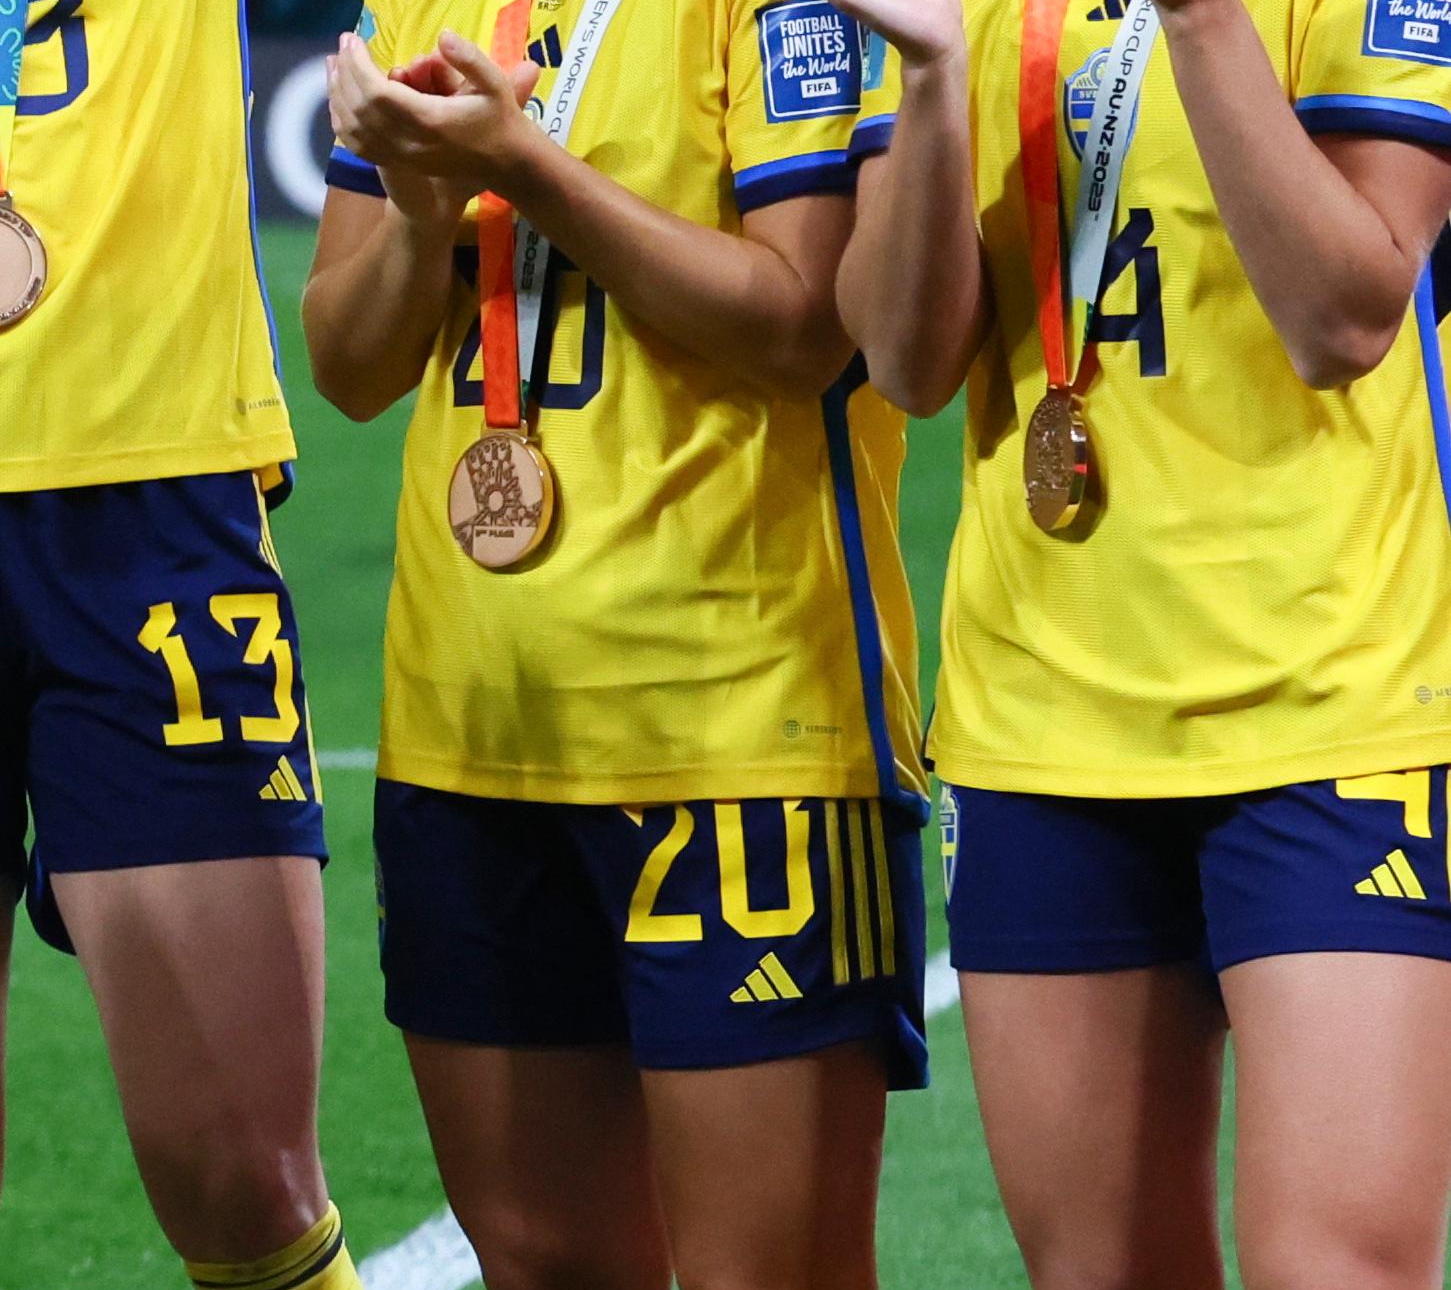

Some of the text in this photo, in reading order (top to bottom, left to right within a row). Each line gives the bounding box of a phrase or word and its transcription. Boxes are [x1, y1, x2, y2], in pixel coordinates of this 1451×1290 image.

[780, 14, 843, 37] FOOTBALL
[1410, 26, 1433, 38] FIFA
[783, 31, 846, 59] UNITES
[1120, 36, 1140, 76] CUP
[557, 46, 588, 112] WORLD
[780, 53, 851, 79] the World
[806, 82, 832, 93] FIFA
[1091, 210, 1165, 376] 4
[138, 592, 300, 746] 13
[622, 799, 816, 943] 20
